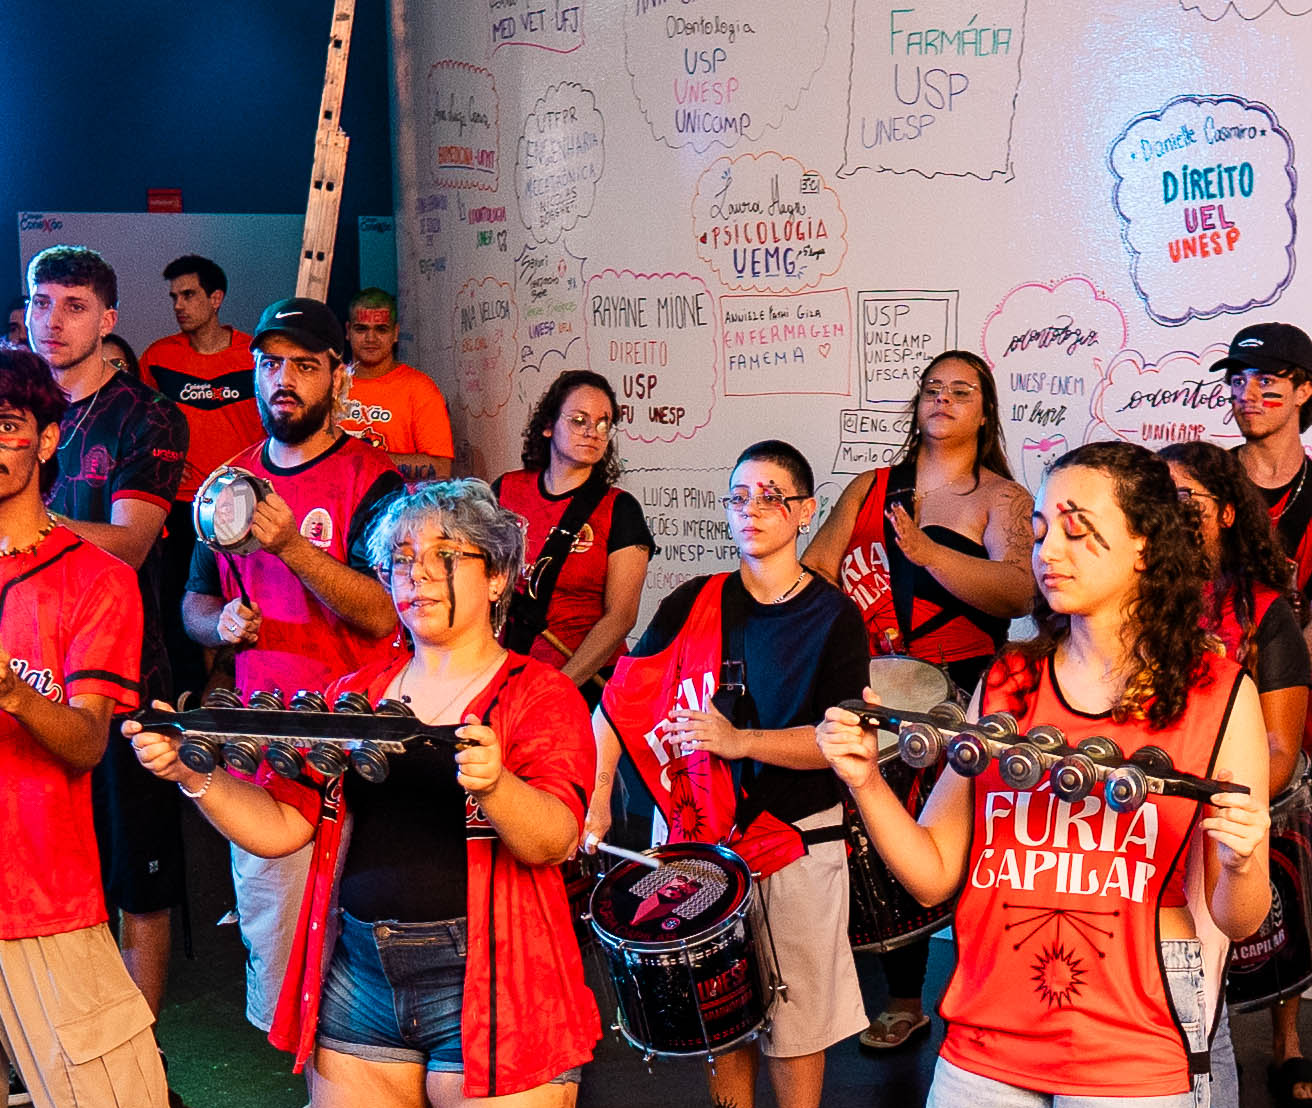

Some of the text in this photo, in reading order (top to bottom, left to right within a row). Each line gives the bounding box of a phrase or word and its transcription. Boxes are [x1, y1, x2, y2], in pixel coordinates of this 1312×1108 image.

[492, 17, 517, 42] MED
[520, 9, 547, 32] VET
[683, 47, 727, 75] USP
[673, 76, 739, 105] UNESP
[894, 64, 969, 112] USP
[860, 114, 936, 148] UNESP
[1184, 205, 1235, 232] UEL
[1168, 227, 1240, 263] UNESP
[733, 246, 797, 276] UEMG
[592, 295, 648, 328] RAYANE
[866, 304, 911, 328] USP
[724, 323, 845, 348] ENFERMAGEM
[866, 331, 932, 350] UNICAMP
[609, 340, 669, 367] DIREITO
[729, 346, 806, 370] FAMEMA
[623, 373, 658, 400] USP
[648, 405, 686, 426] UNESP
[1116, 378, 1234, 425] odontolo
[842, 447, 878, 462] Murilo
[683, 486, 716, 511] PAIVA
[645, 512, 734, 541] AÇÕES INTERNAC
[841, 542, 890, 594] RIA
[984, 780, 1160, 860] FÚRIA
[971, 848, 1157, 904] CAPILAR
